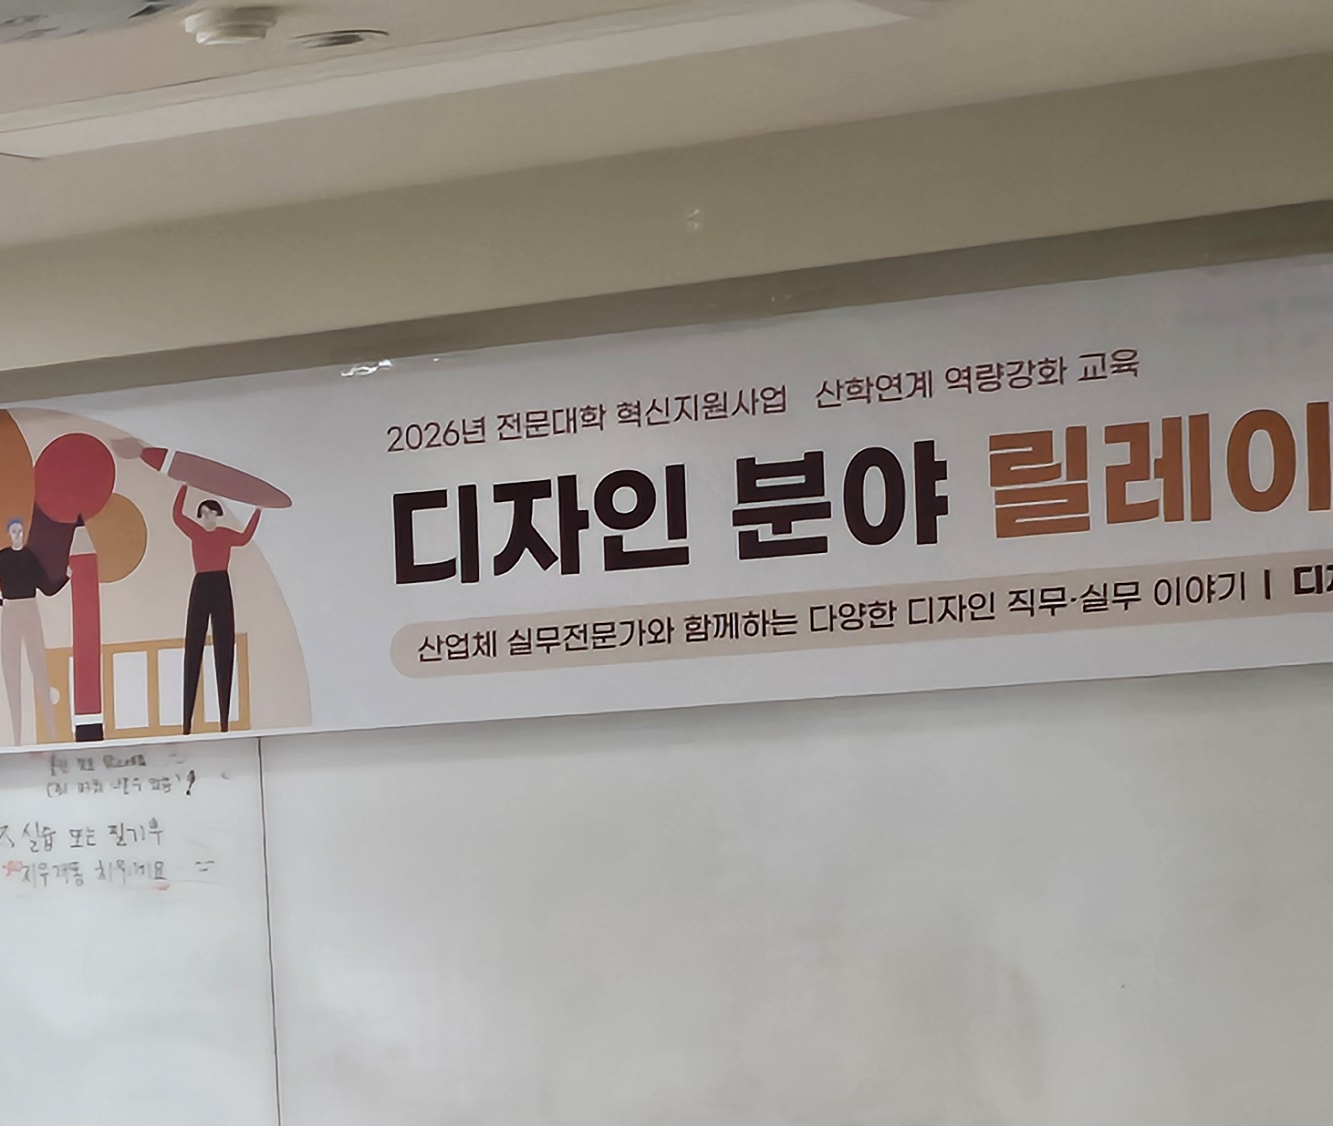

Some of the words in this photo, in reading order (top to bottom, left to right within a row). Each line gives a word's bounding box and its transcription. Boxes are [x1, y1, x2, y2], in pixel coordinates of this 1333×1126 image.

[386, 416, 487, 453] 2026년
[496, 403, 607, 442] 전문대학
[616, 384, 788, 428] 혁신지원사업
[815, 369, 934, 409] 산학연계
[944, 355, 1068, 395] 역량강화
[1076, 348, 1140, 382] 교육
[392, 462, 690, 586] 디자인
[731, 439, 949, 560] 분야
[988, 400, 1332, 539] 릴레이
[417, 628, 498, 665] 산업체
[507, 617, 676, 658] 실무전문가와
[684, 608, 799, 643] 함께하는
[809, 599, 898, 634] 다양한
[907, 590, 997, 626] 디자인
[1007, 579, 1143, 618] 직무·실무
[1153, 570, 1246, 607] 이야기
[20, 821, 57, 854] 실습
